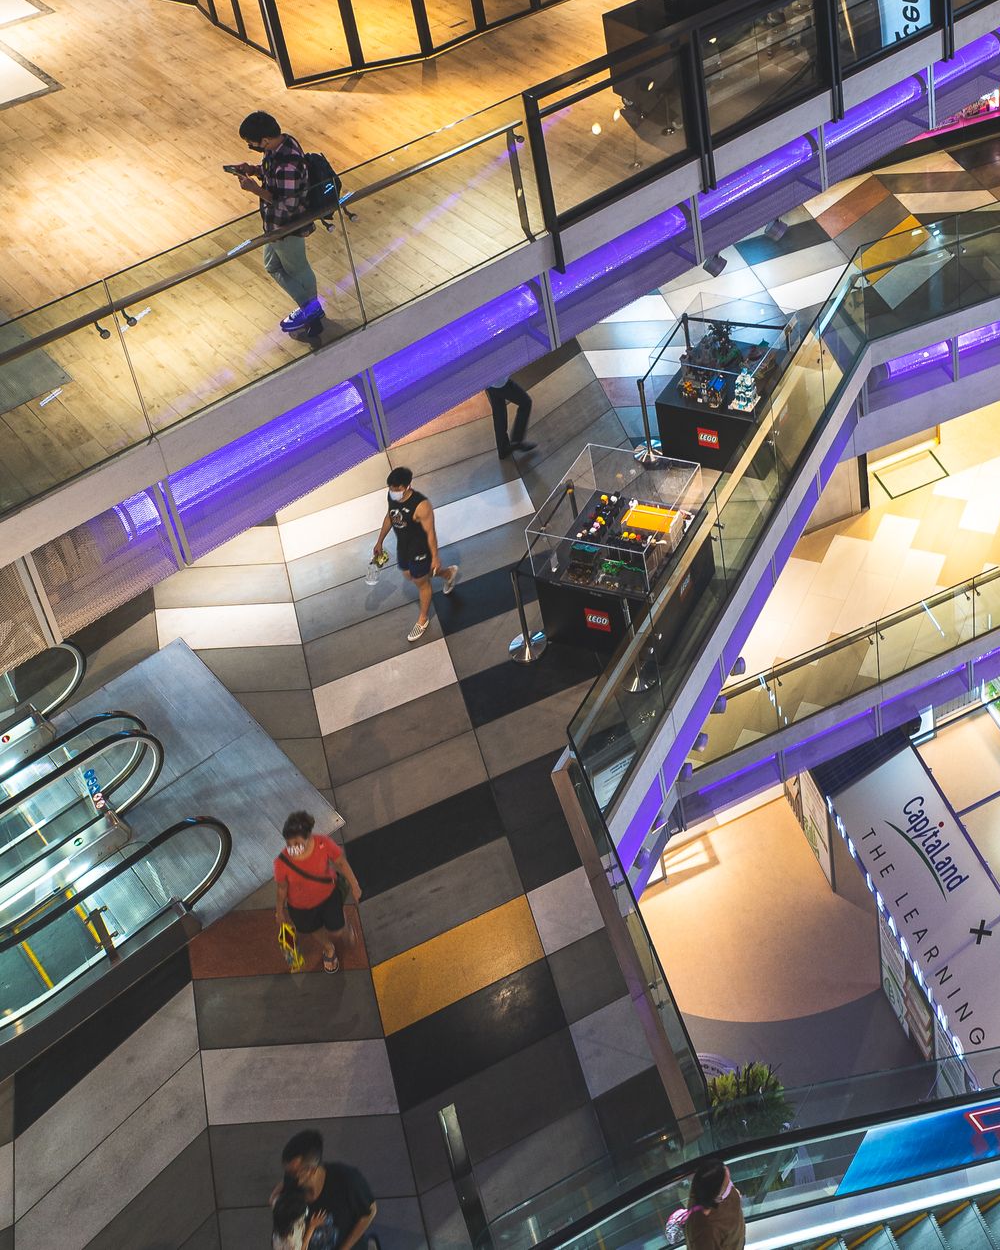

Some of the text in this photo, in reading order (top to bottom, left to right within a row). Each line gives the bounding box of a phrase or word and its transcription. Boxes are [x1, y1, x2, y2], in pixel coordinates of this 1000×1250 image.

[698, 433, 718, 445] LEGO
[586, 613, 608, 627] LEGO
[861, 827, 895, 879] THE
[894, 893, 986, 1046] LEARNING
